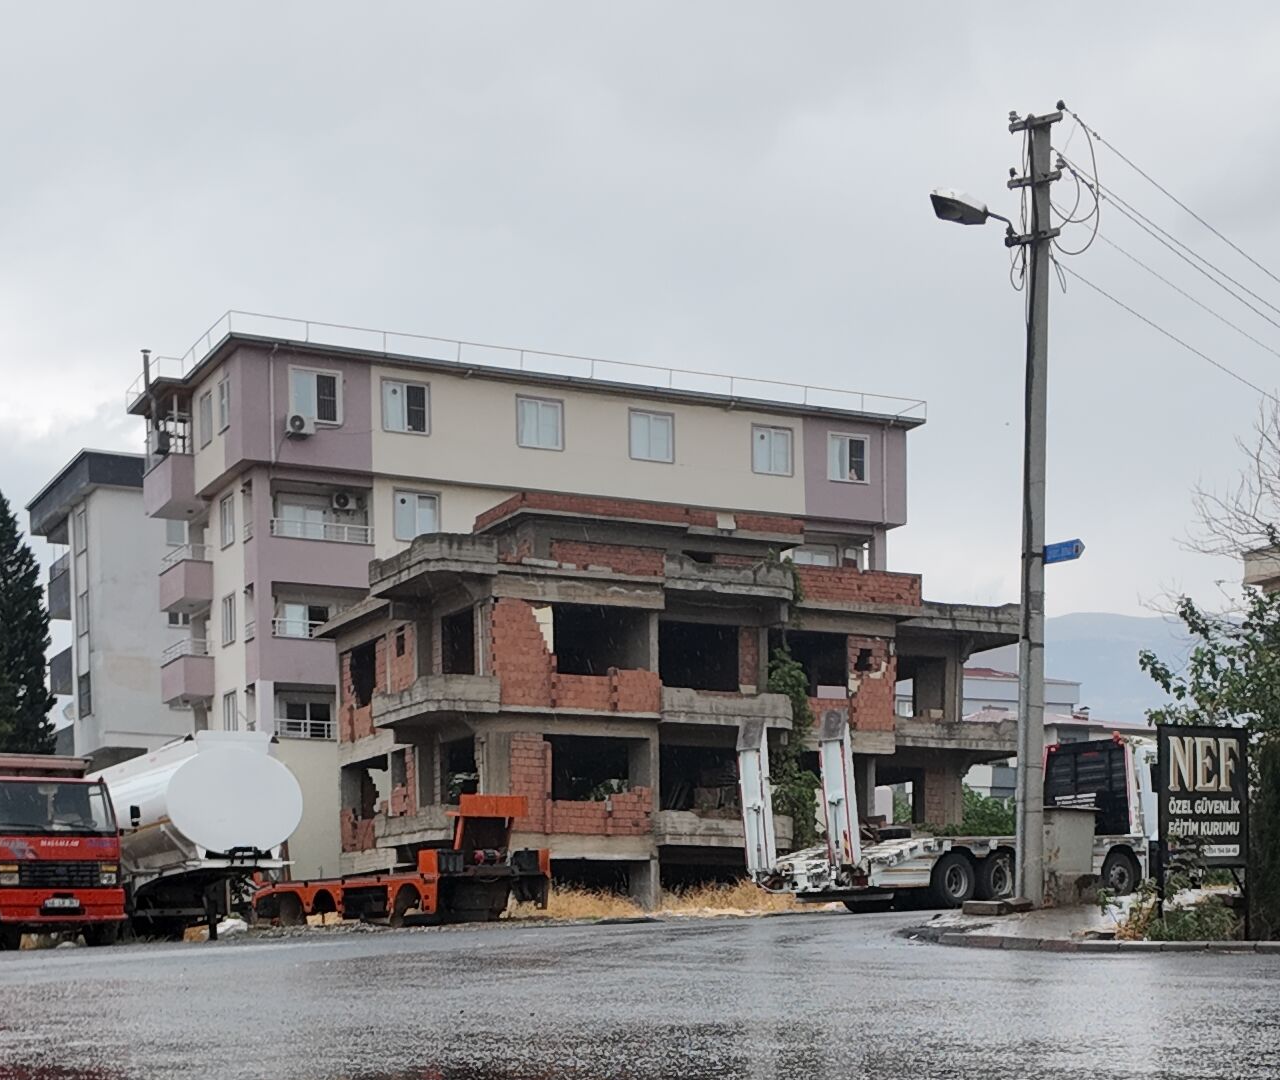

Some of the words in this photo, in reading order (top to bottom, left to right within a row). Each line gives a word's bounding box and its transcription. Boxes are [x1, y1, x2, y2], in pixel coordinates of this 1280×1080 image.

[1168, 736, 1240, 791] NEF
[1169, 797, 1192, 814] ÖZEL
[1195, 797, 1240, 814] GÜVENLİK
[1169, 819, 1199, 838] EĞİTİM
[1201, 821, 1240, 836] KURUMU
